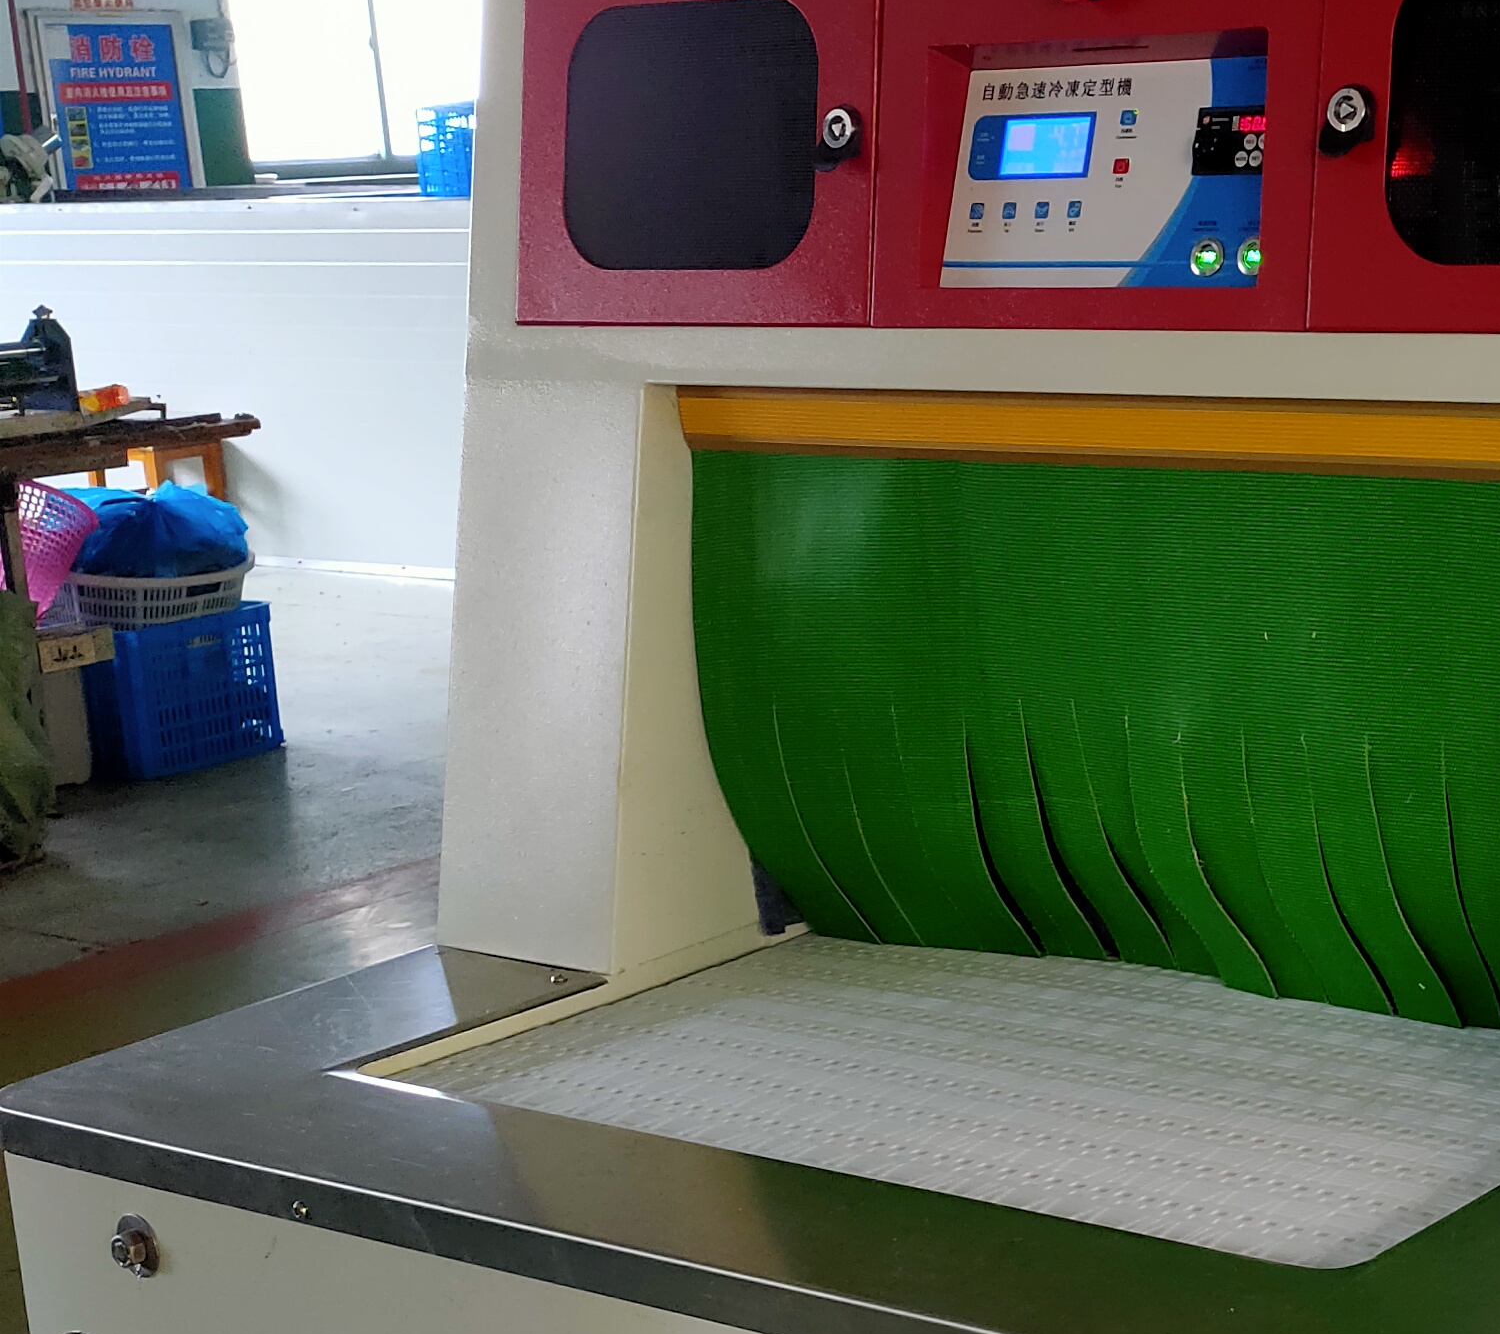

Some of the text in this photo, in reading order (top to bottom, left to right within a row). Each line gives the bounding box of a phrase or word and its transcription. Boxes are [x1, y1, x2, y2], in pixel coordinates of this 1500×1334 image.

[69, 34, 156, 63] 消防栓
[70, 67, 157, 79] FIRE HYDRANT
[982, 77, 1133, 101] 自動急速冷凍定型機
